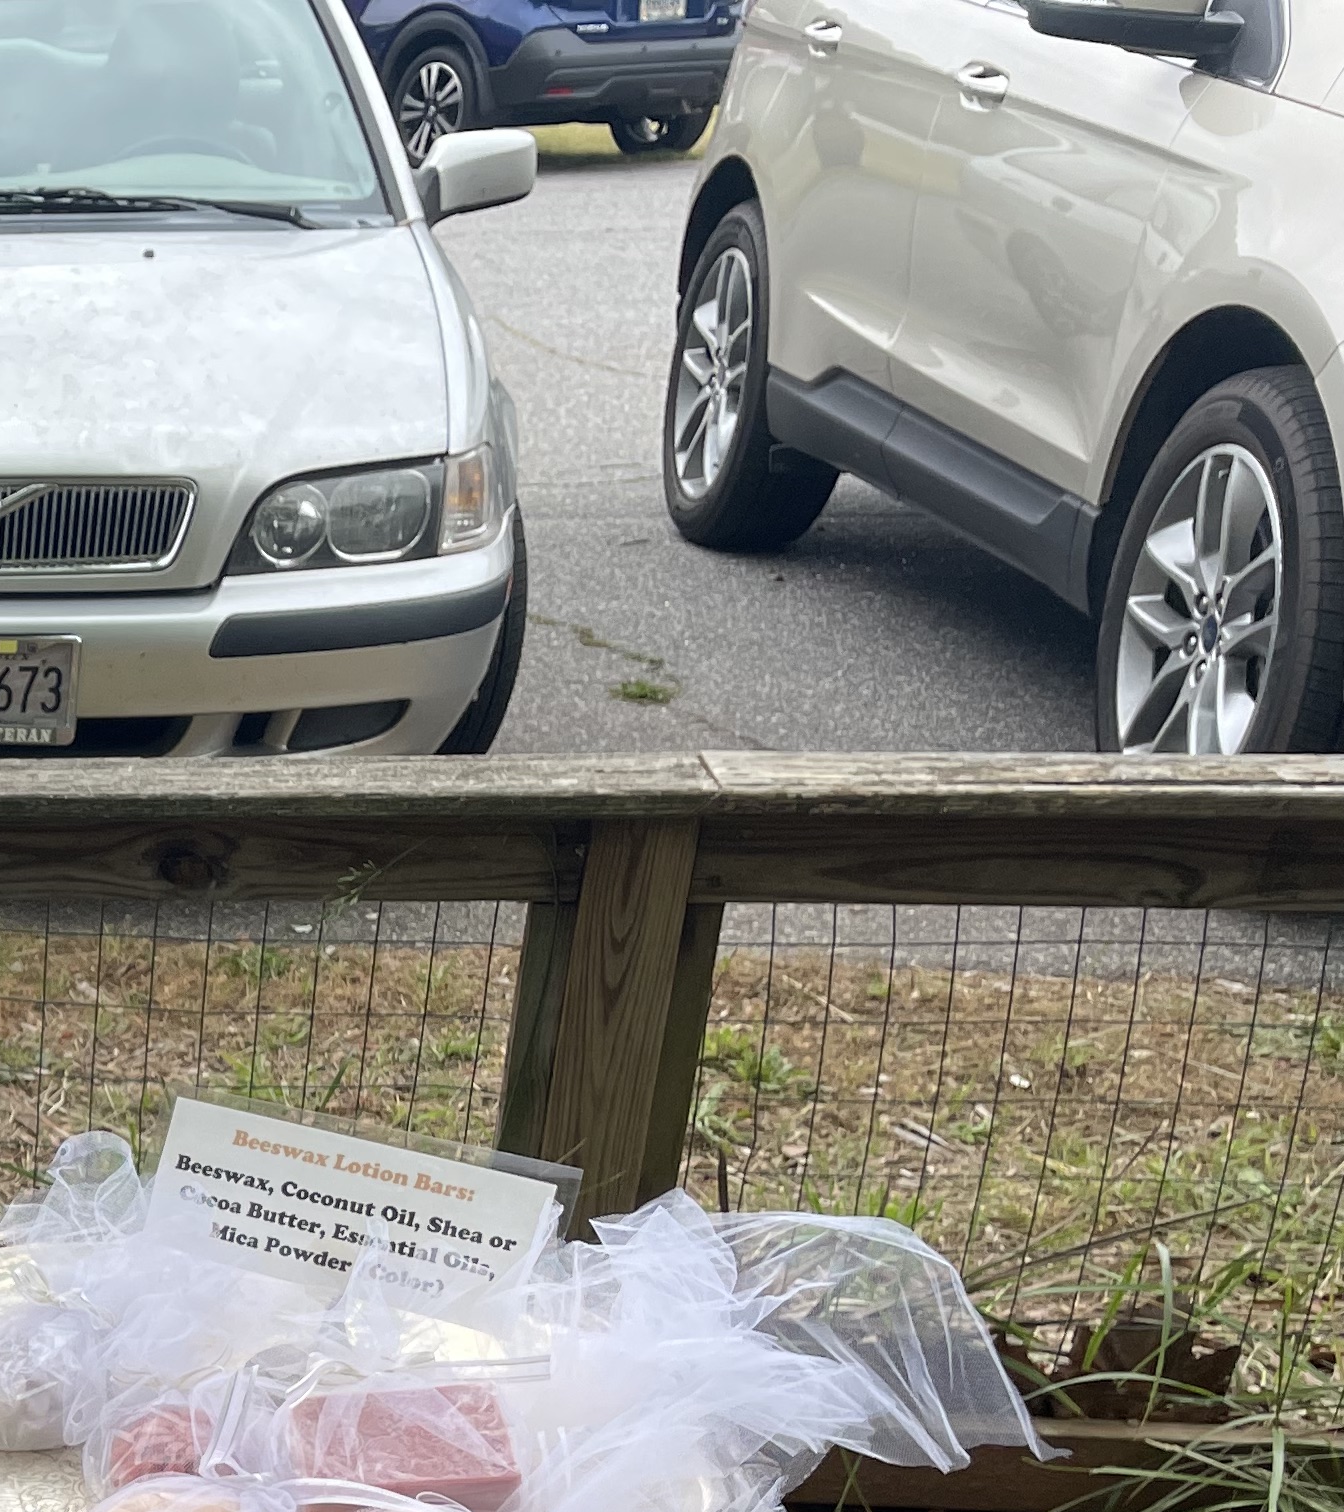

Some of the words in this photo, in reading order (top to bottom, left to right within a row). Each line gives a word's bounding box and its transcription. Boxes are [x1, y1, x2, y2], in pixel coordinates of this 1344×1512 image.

[232, 1129, 329, 1167] Beeswax
[333, 1154, 408, 1186] Lotion
[414, 1173, 475, 1201] Bars:
[175, 1154, 274, 1196] Beeswax,
[281, 1181, 375, 1216] Coconut
[381, 1205, 420, 1232] Oil,
[427, 1216, 482, 1244] Shea
[489, 1236, 517, 1251] or
[179, 1185, 242, 1214] Cocoa
[246, 1201, 326, 1240] Butter,
[210, 1222, 258, 1249] Mica
[264, 1236, 352, 1272] Powder
